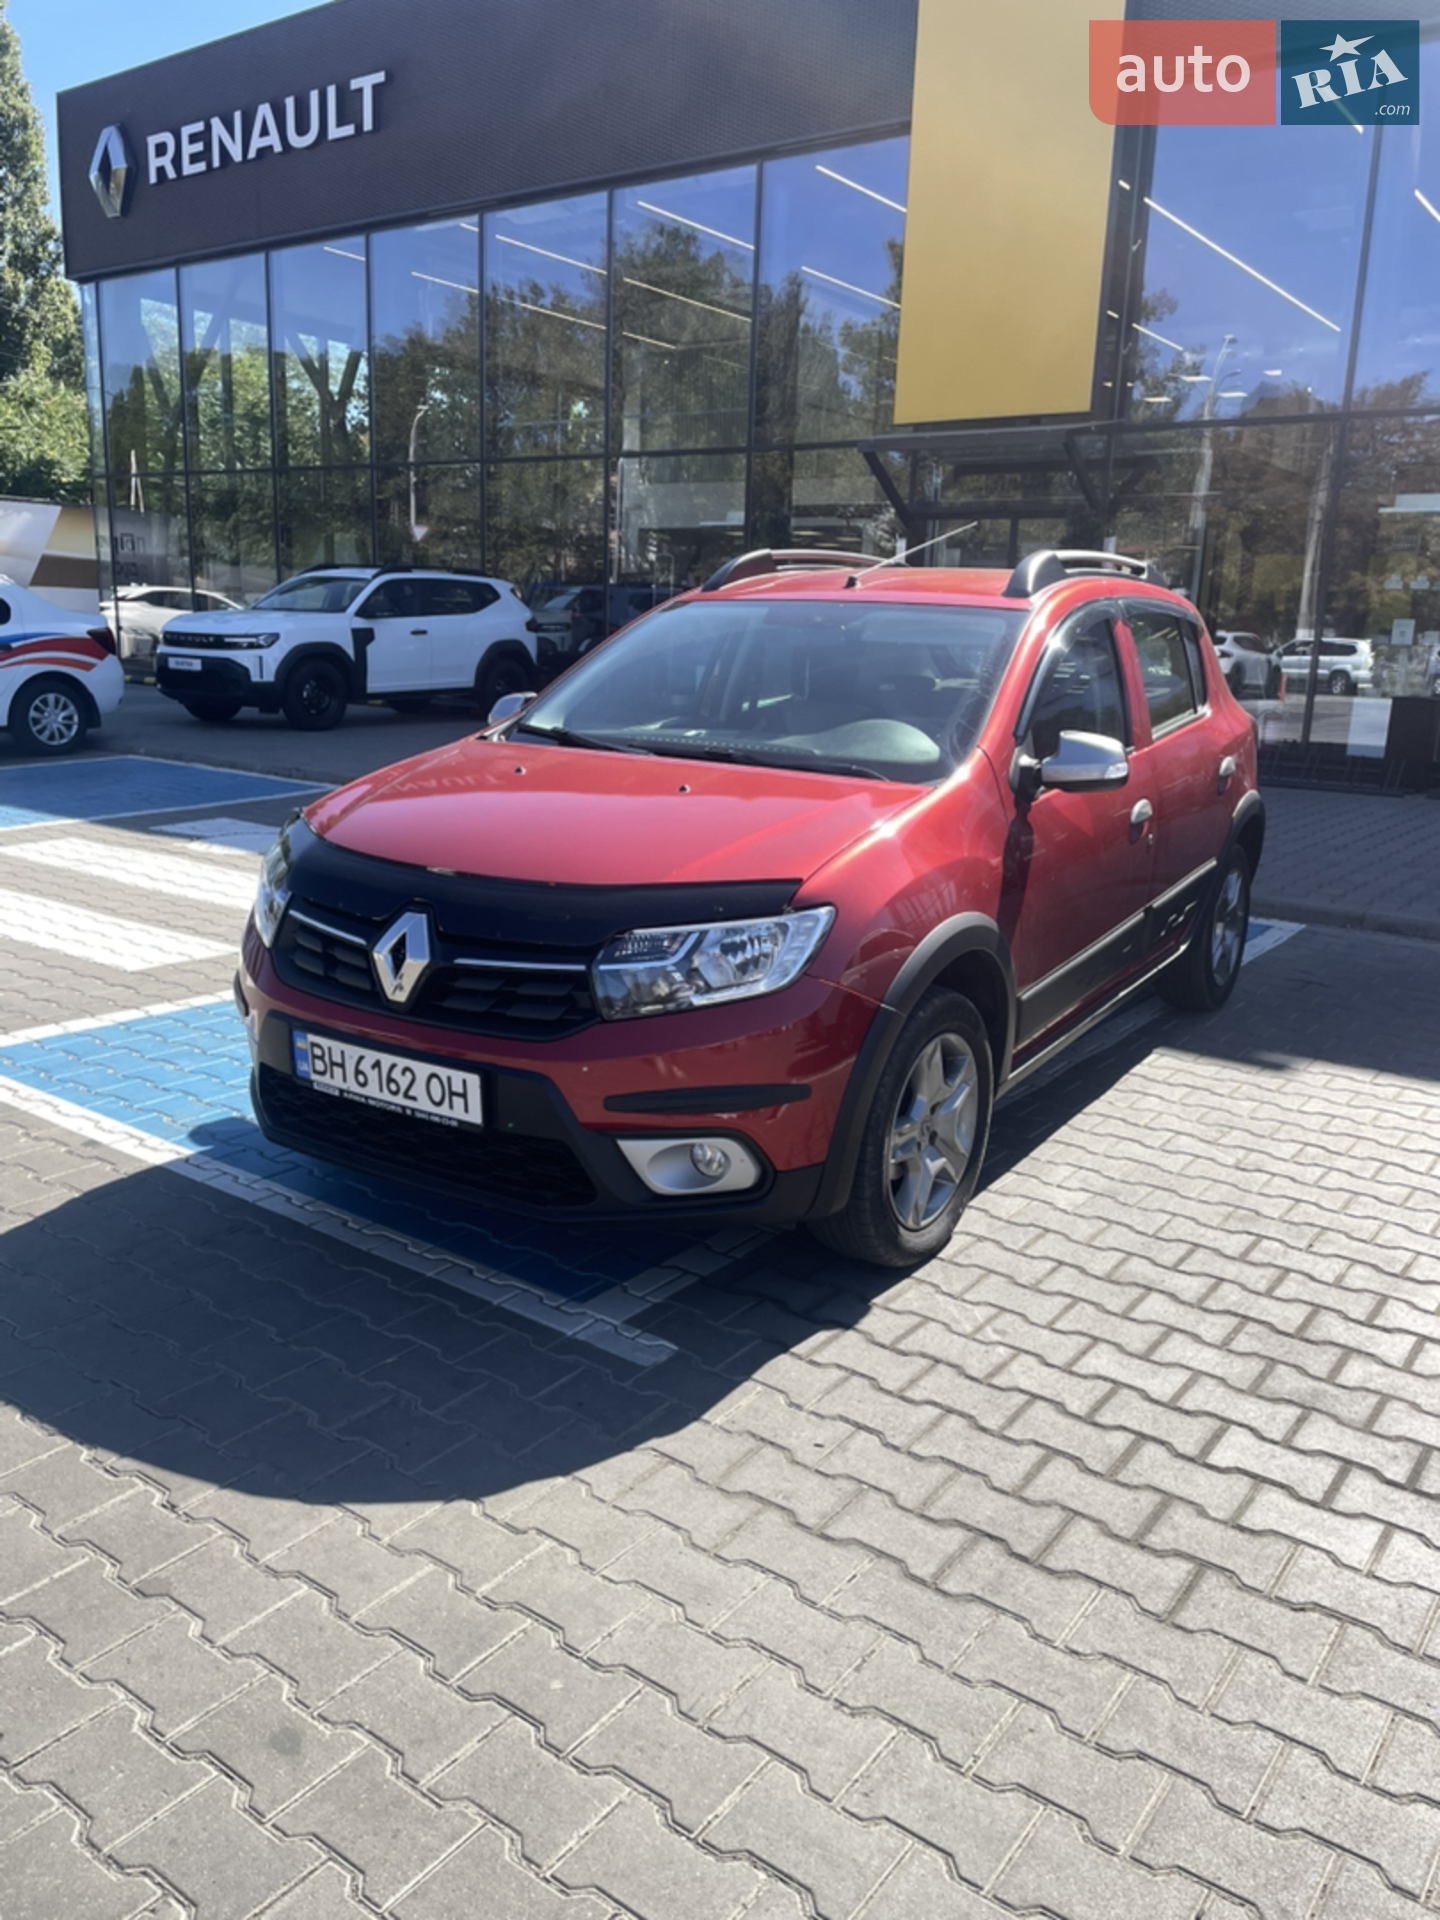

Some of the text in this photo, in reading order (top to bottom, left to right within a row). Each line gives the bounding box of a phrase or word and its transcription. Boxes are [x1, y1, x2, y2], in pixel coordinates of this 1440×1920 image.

[146, 70, 386, 185] RENAULT
[310, 1041, 470, 1115] BH 6162 OH
